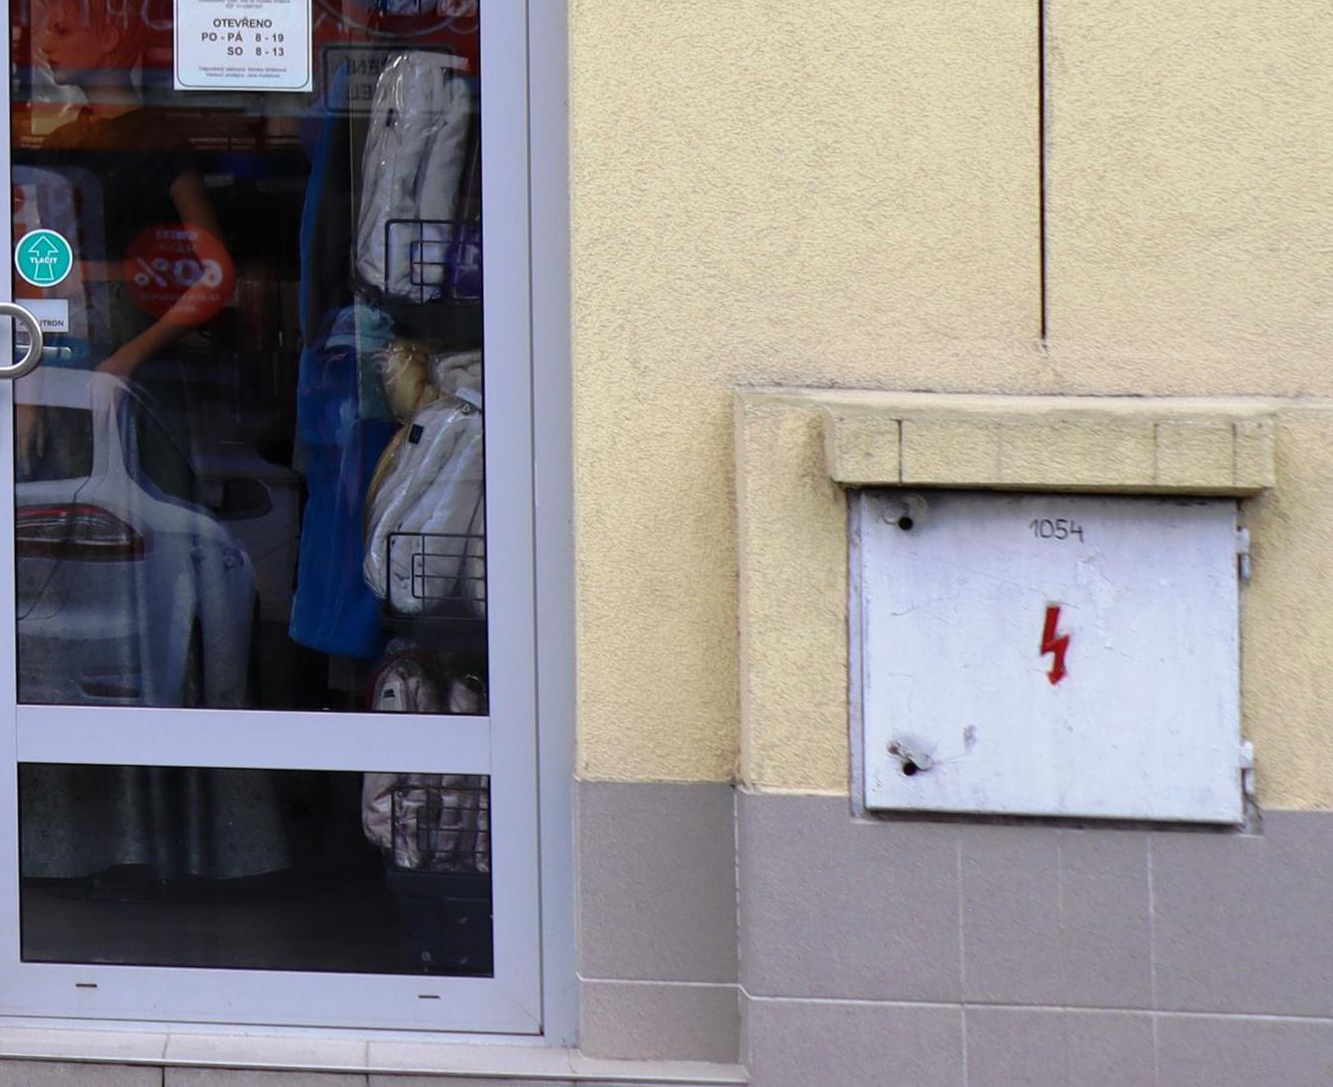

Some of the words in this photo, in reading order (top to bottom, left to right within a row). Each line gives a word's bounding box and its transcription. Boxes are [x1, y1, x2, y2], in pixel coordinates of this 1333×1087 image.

[213, 17, 272, 28] OTEVŘENO
[201, 32, 217, 42] PO
[227, 31, 243, 42] PÁ
[255, 33, 261, 42] 8
[272, 33, 284, 43] 19
[227, 46, 243, 56] SO
[255, 47, 261, 56] 8
[272, 47, 284, 56] 13
[1028, 518, 1084, 543] 1054
